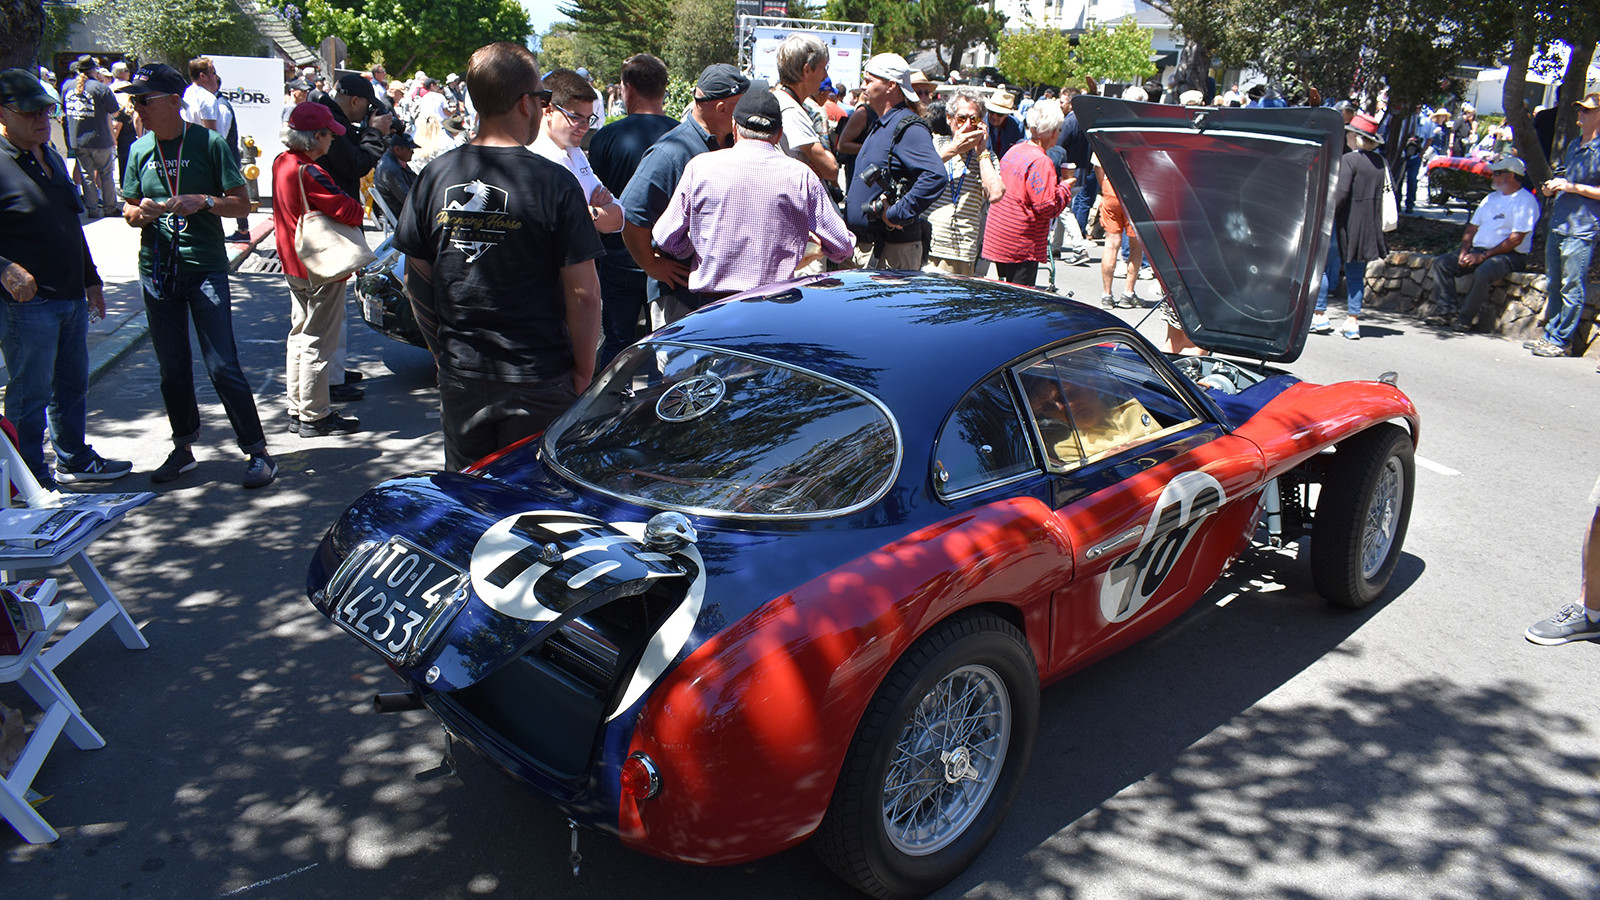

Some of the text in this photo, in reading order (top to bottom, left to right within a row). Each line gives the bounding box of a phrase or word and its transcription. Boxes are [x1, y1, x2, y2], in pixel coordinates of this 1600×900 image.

[158, 169, 177, 177] 145
[486, 214, 523, 230] Horse
[343, 585, 424, 653] 4253
